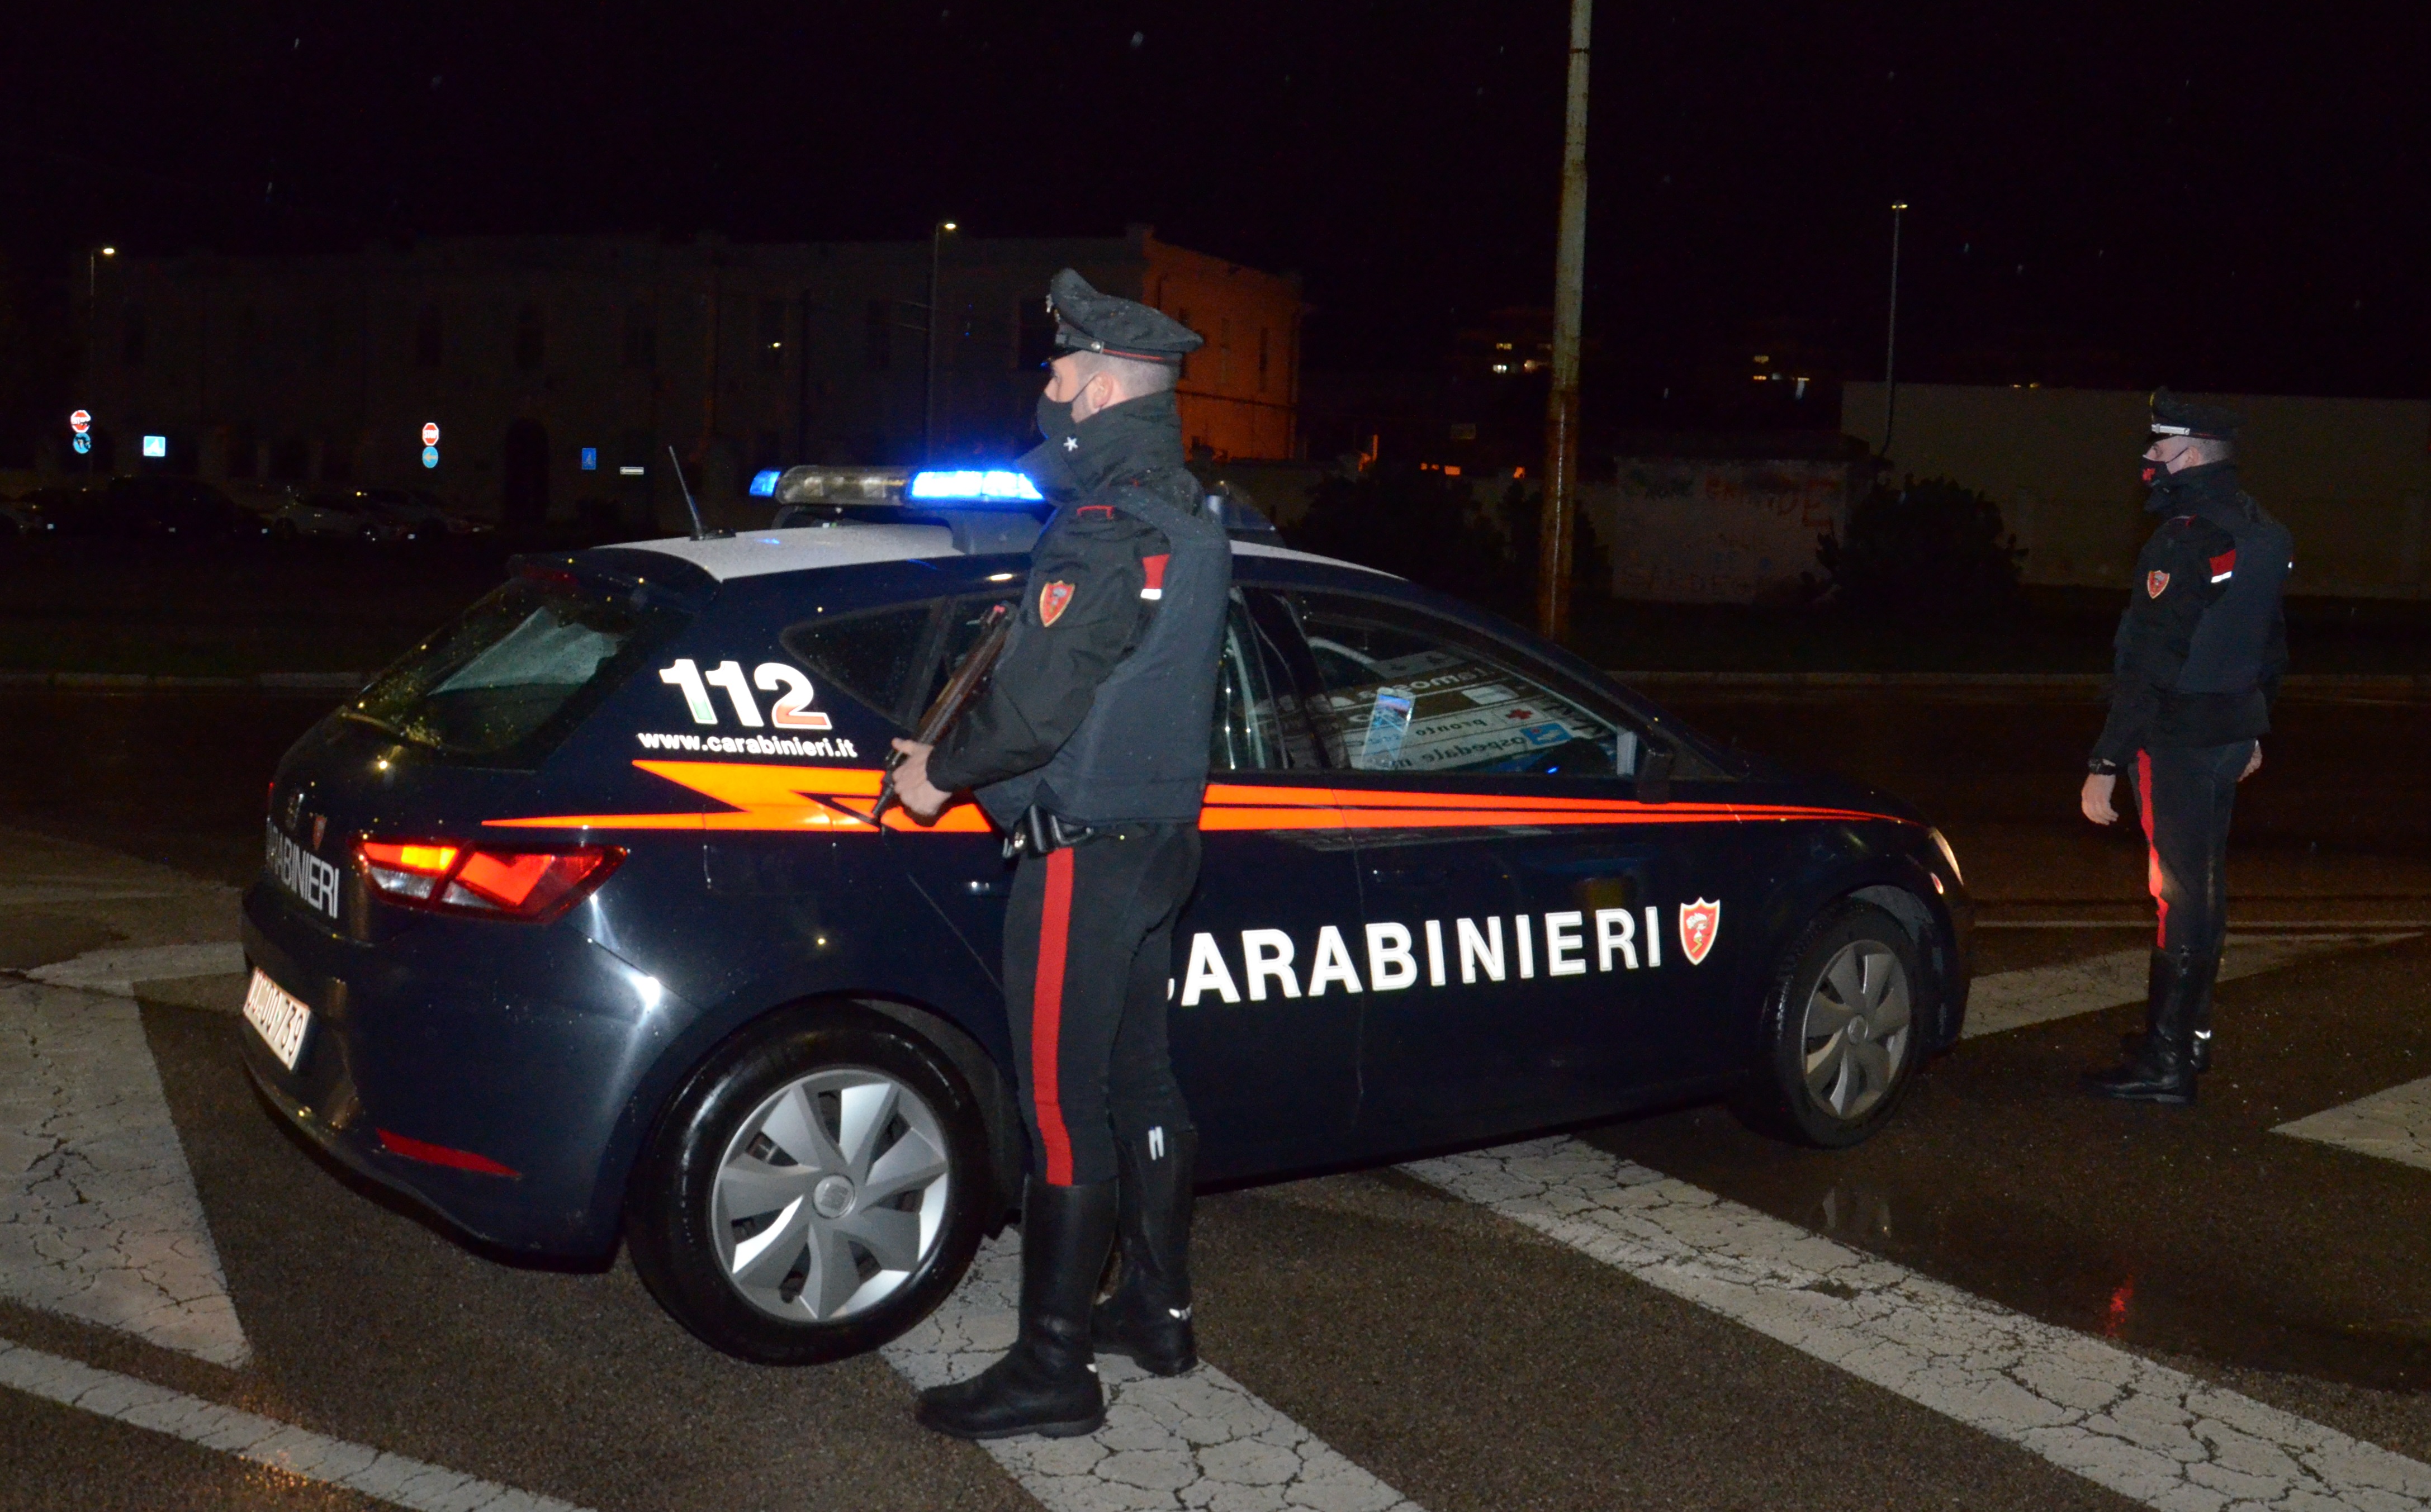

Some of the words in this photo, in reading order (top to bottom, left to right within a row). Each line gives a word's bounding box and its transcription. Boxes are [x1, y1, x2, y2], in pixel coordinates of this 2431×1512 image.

[424, 429, 438, 439] STOP
[658, 658, 832, 730] 112
[637, 732, 858, 758] www.carabinieri.it
[1167, 905, 1661, 1007] ARABINIERI
[273, 997, 305, 1056] 739
